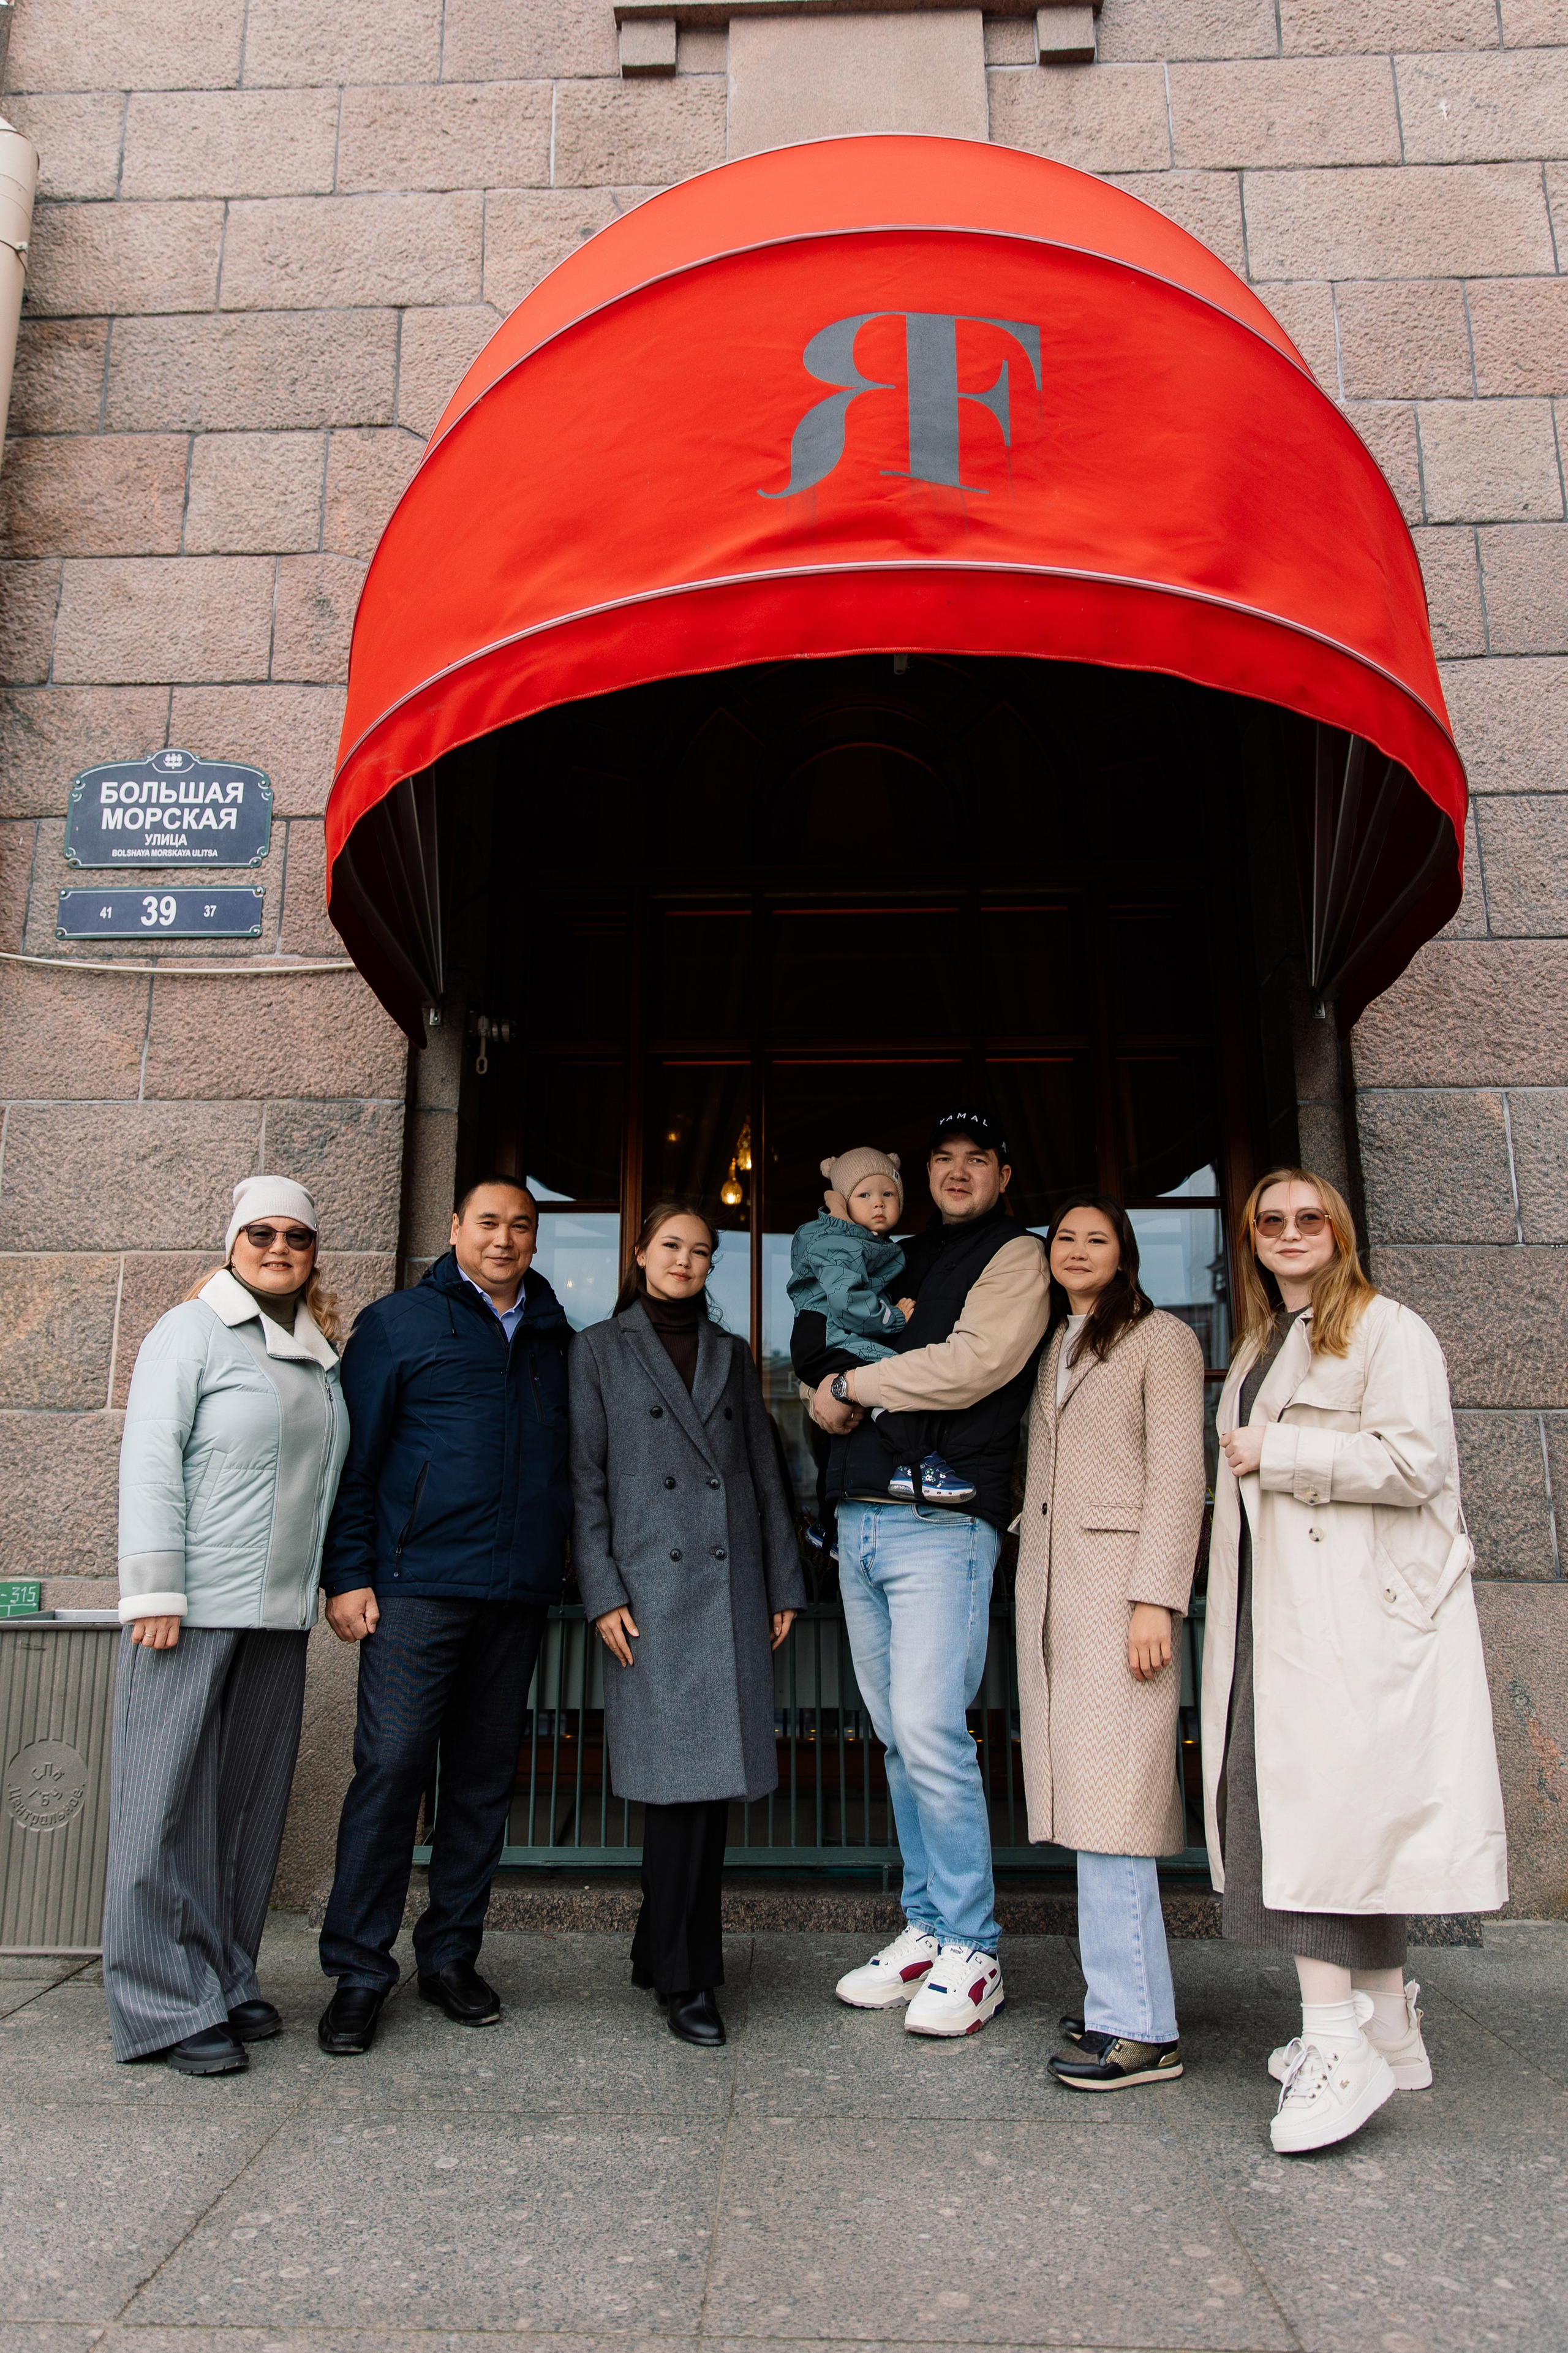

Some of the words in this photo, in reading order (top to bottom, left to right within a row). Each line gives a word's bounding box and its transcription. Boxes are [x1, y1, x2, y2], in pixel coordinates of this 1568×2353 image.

[100, 781, 244, 804] БОЛЬШАЯ
[101, 807, 238, 830] МОРСКАЯ
[145, 833, 187, 848] УЛИЦА
[100, 907, 112, 919] 41
[140, 896, 177, 926] 39
[203, 905, 217, 917] 37
[940, 1112, 988, 1127] YAMAL
